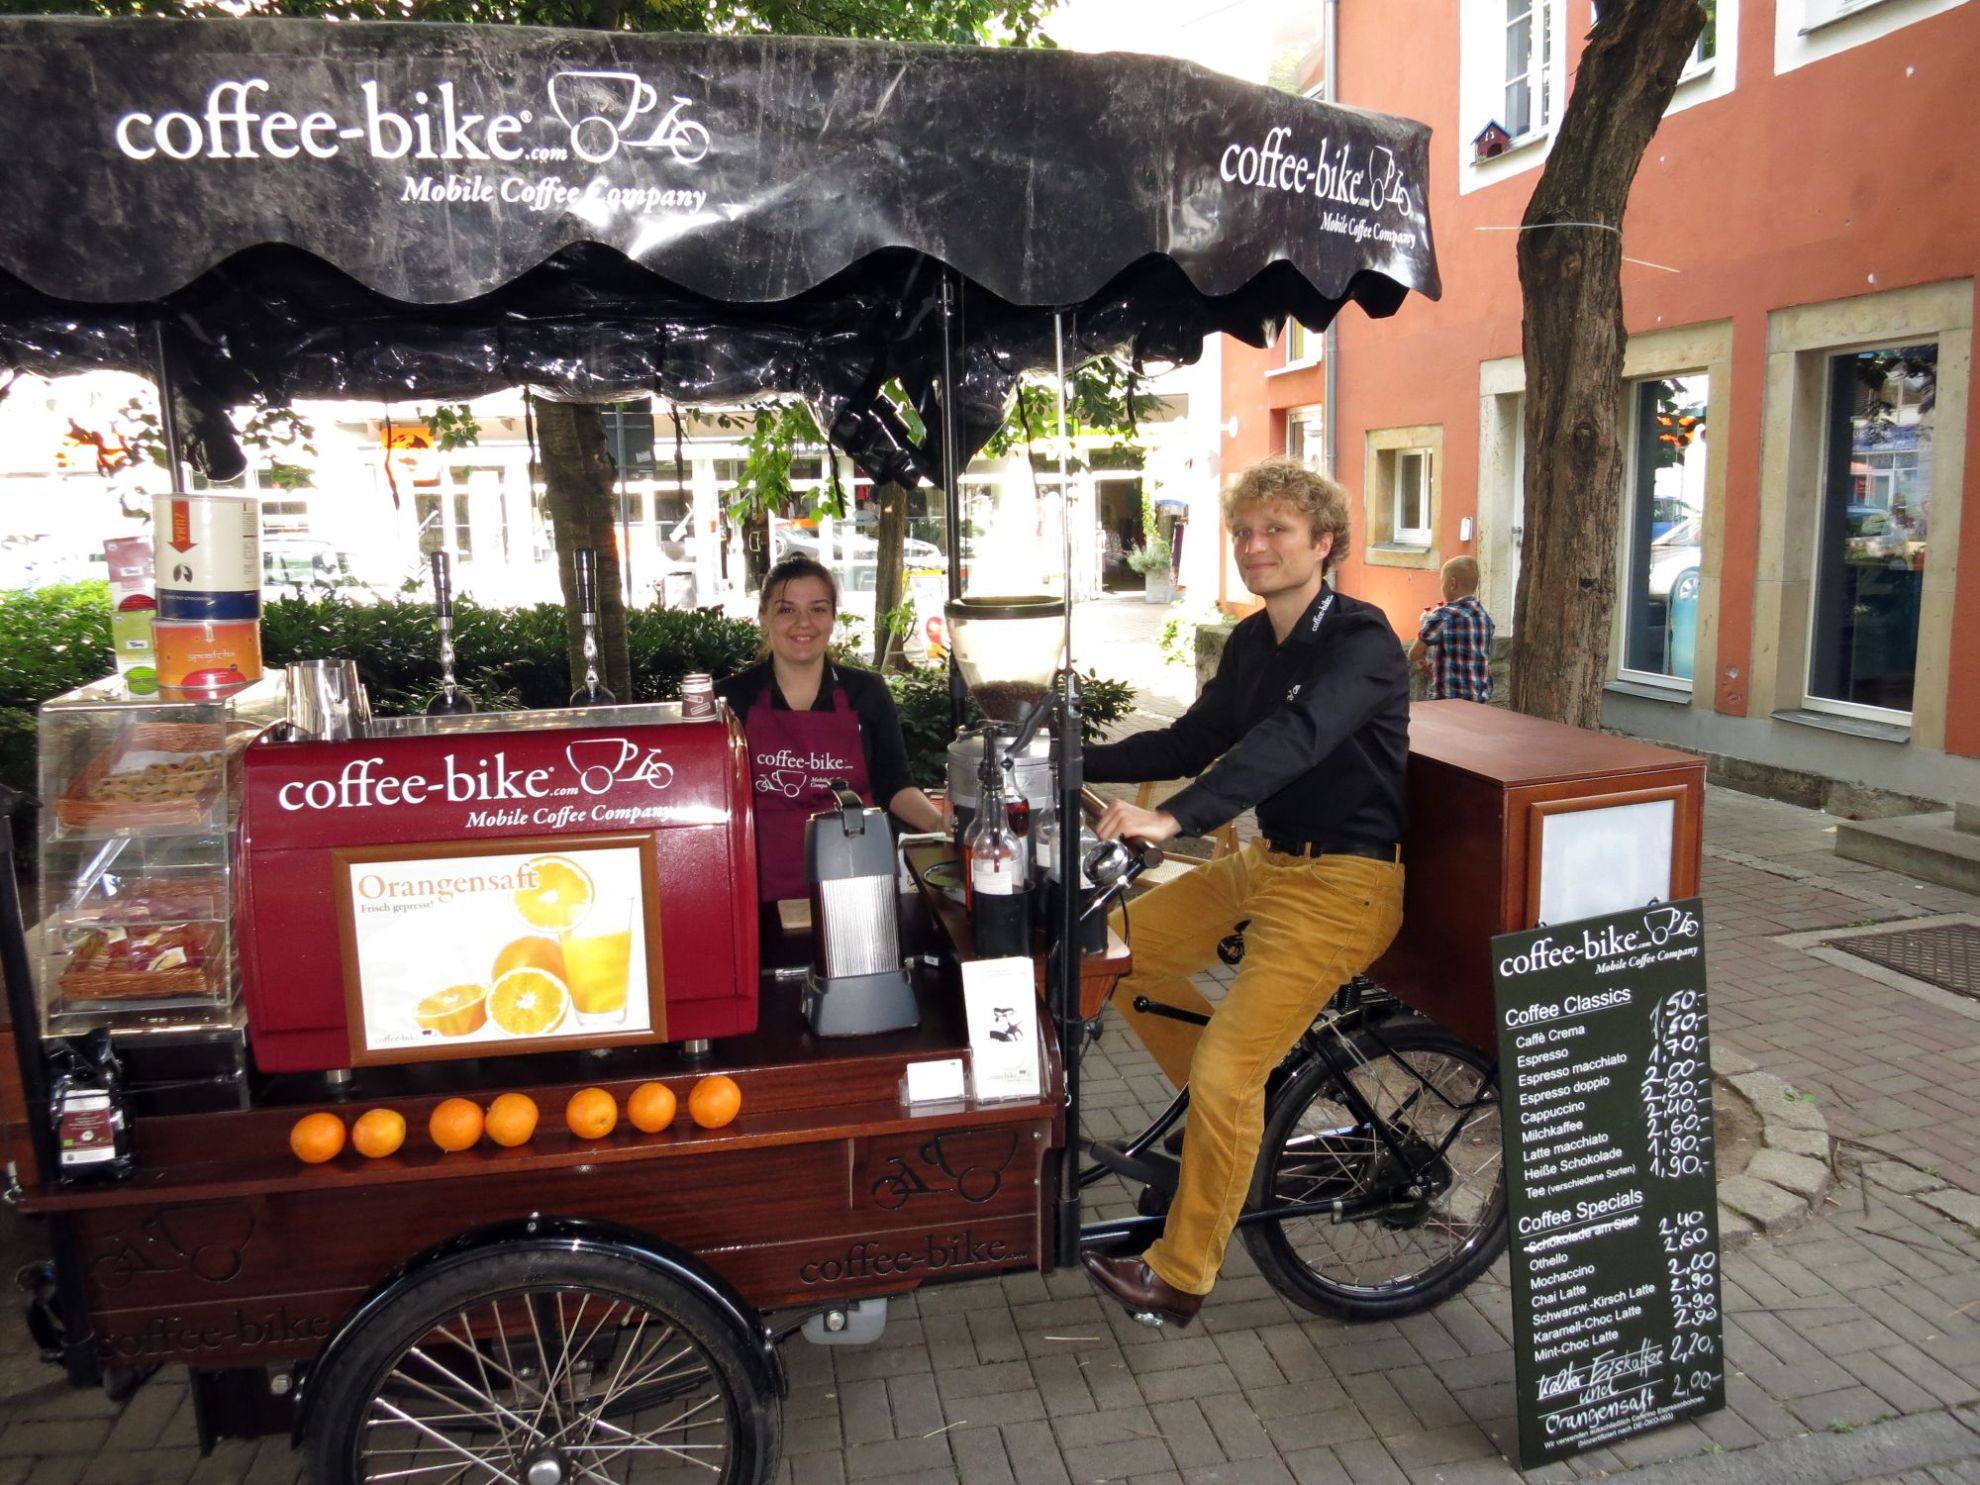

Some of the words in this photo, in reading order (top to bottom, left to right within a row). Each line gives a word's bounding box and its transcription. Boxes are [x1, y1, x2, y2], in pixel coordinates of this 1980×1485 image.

[401, 175, 494, 203] Mobile
[501, 177, 580, 211] Coffee
[588, 180, 707, 214] Company
[1320, 211, 1348, 234] Mobile
[1348, 217, 1373, 243] Coffee
[1373, 222, 1416, 249] Company
[465, 808, 529, 829] Mobile
[532, 806, 588, 829] Coffee
[591, 803, 674, 825] Company
[358, 862, 538, 903] Orangensaft
[360, 903, 391, 914] Frisch
[393, 900, 434, 914] gepresst!
[1499, 925, 1637, 977] coffee-bike
[1595, 959, 1627, 975] Mobile
[1628, 954, 1656, 968] Coffee
[1657, 946, 1699, 961] Company
[1505, 1001, 1559, 1026] Coffee
[1564, 988, 1632, 1014] Classics
[1516, 1031, 1546, 1048] Caffè
[1548, 1024, 1585, 1041] Crema
[1517, 1048, 1569, 1068] Espresso
[1518, 1066, 1570, 1087] Espresso
[1572, 1052, 1627, 1075] macchiato
[1520, 1085, 1571, 1106] Espresso
[1573, 1075, 1610, 1095] doppio
[1520, 1101, 1585, 1125] Cappuccino
[1521, 1119, 1584, 1144] Milchkaffee
[1523, 1145, 1551, 1163] Latte
[1553, 1132, 1609, 1156] macchiato
[1524, 1164, 1557, 1181] Heiße
[1559, 1147, 1623, 1172] Schokolade
[1525, 1186, 1546, 1199] Tee
[1547, 1173, 1605, 1195] (verschiedene
[1606, 1164, 1636, 1179] Sorten)
[1518, 1209, 1572, 1234] Coffee
[1576, 1188, 1644, 1220] Specials
[799, 1230, 1006, 1285] coffee-bike
[1529, 1253, 1569, 1271] Othello
[1530, 1264, 1595, 1290] Mochaccino
[1531, 1290, 1557, 1308] Chai
[1559, 1284, 1587, 1302] Latte
[1532, 1290, 1627, 1326] Schwarzw.-Kirsch
[1629, 1282, 1656, 1299] Latte
[1533, 1312, 1614, 1344] Karamell-Choc
[1615, 1305, 1642, 1322] Latte
[1534, 1337, 1590, 1362] Mint-Choc
[1592, 1329, 1619, 1347] Latte
[1545, 1388, 1655, 1434] Orangensaft
